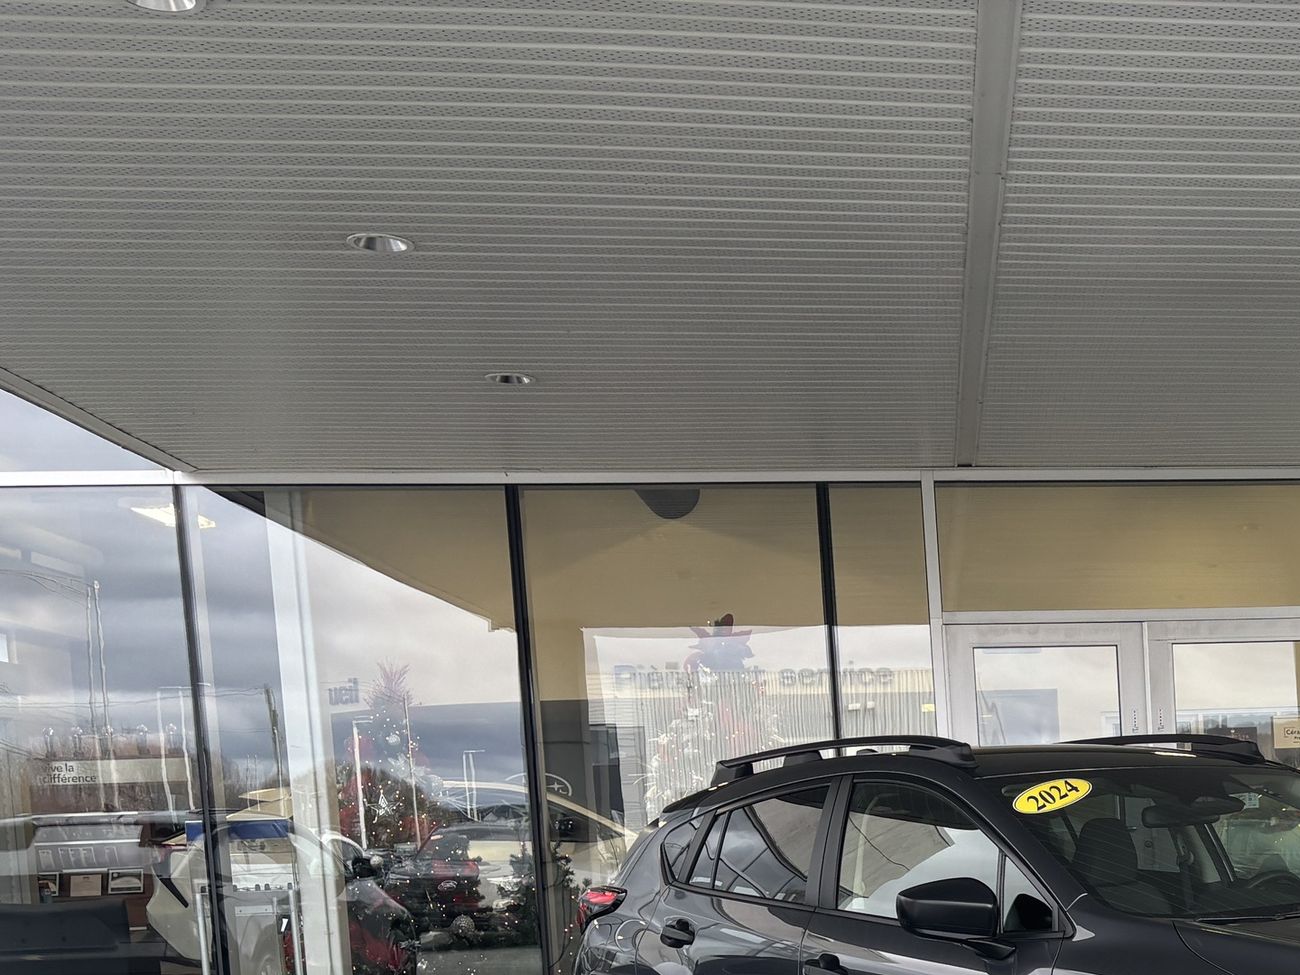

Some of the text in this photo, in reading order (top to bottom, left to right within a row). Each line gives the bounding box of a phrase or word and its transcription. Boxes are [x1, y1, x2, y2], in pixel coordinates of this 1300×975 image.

[64, 763, 74, 773] la
[43, 774, 97, 783] différence
[1027, 780, 1080, 811] 2024
